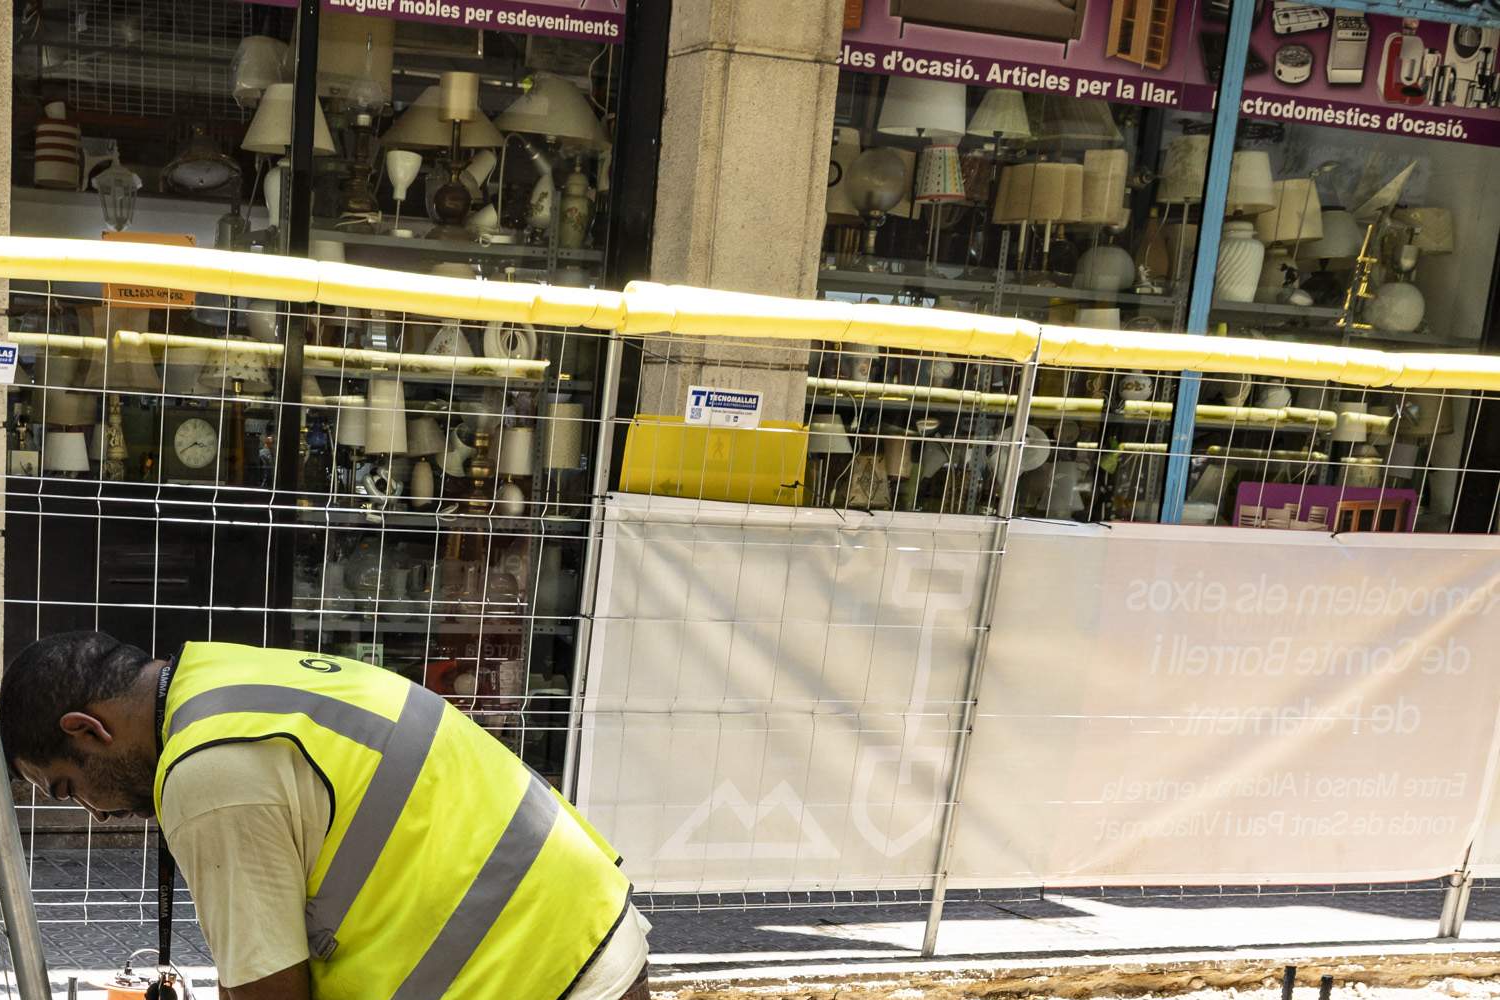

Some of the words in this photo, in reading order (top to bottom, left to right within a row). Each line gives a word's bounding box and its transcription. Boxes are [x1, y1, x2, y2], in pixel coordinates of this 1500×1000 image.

[399, 0, 461, 18] mobles
[464, 9, 491, 25] per
[497, 11, 619, 37] esdeveniments
[883, 50, 981, 80] d’ocasió.
[986, 62, 1070, 91] Articles
[1076, 79, 1111, 98] per
[1116, 79, 1134, 99] la
[1141, 82, 1178, 105] llar.
[1386, 111, 1468, 139] d’ocasió.
[709, 395, 757, 404] TECNOMALLAS
[158, 667, 171, 699] GAMMA
